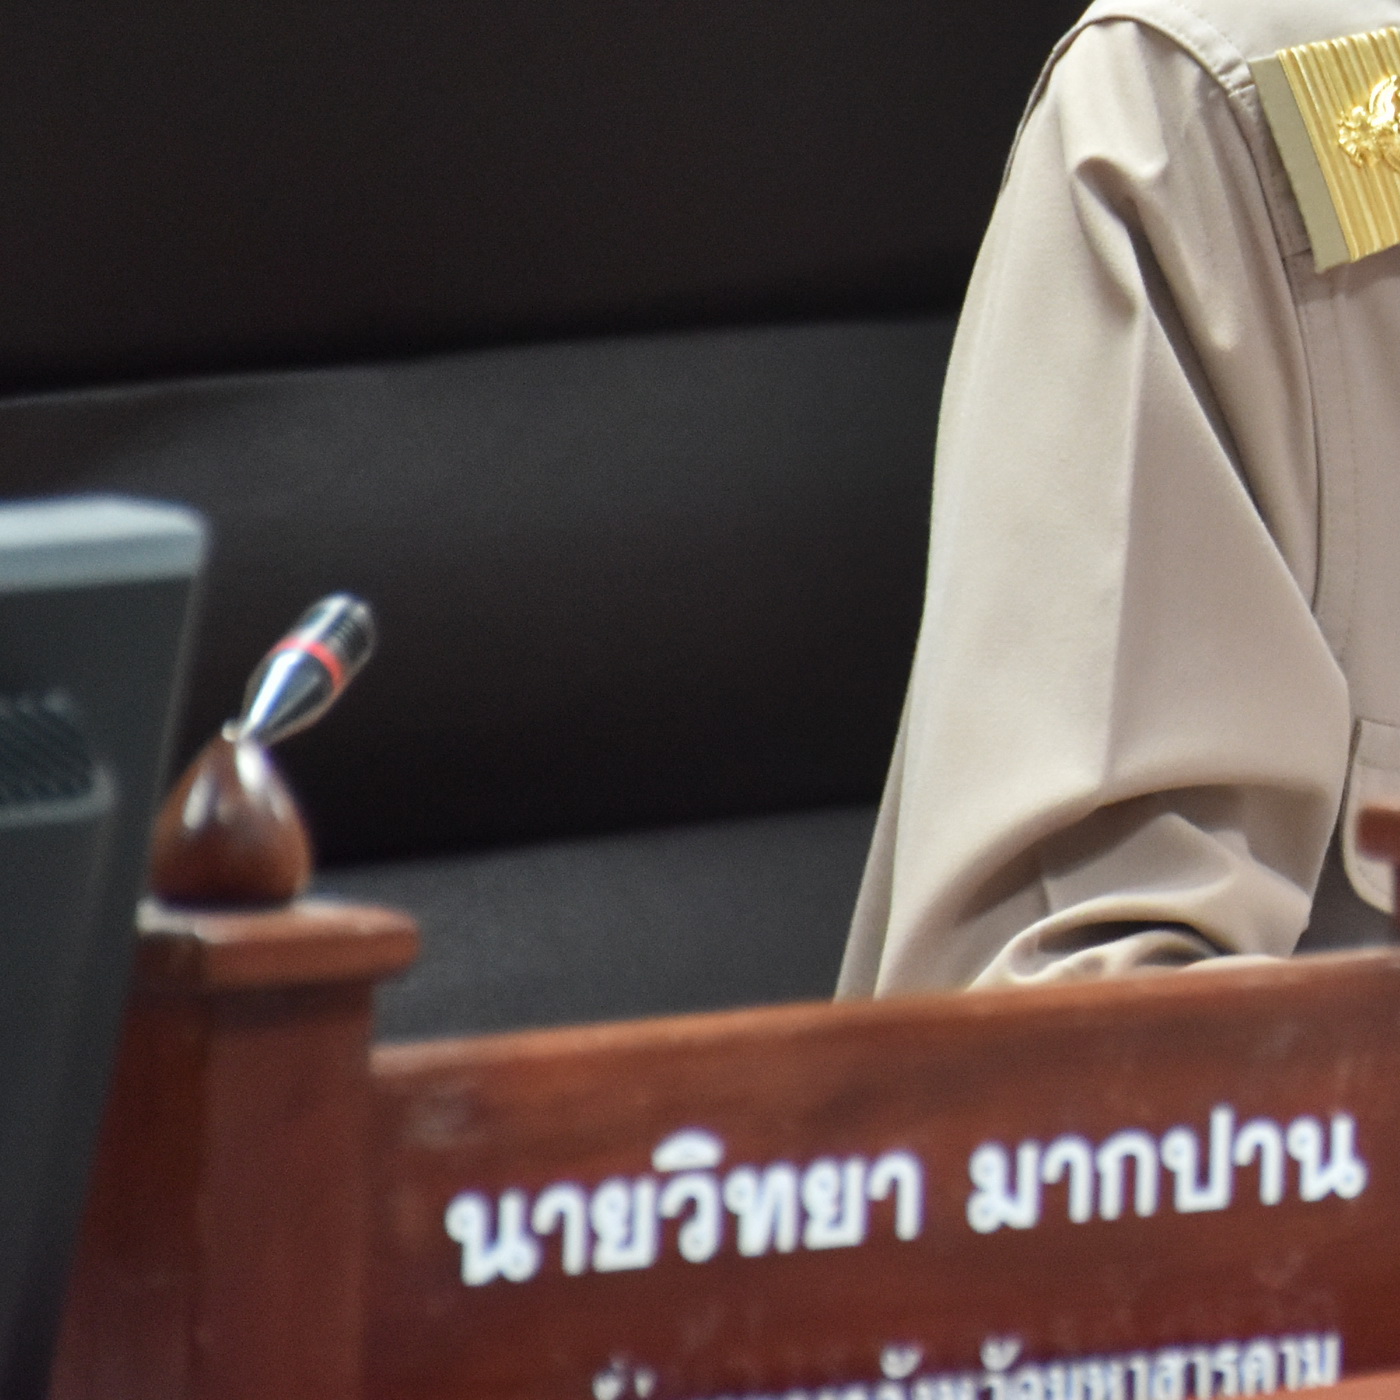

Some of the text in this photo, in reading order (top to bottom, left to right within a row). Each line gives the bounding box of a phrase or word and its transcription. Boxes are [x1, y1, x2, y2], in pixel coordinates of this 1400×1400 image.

[445, 1103, 1367, 1286] นายวิทยา มากปาน
